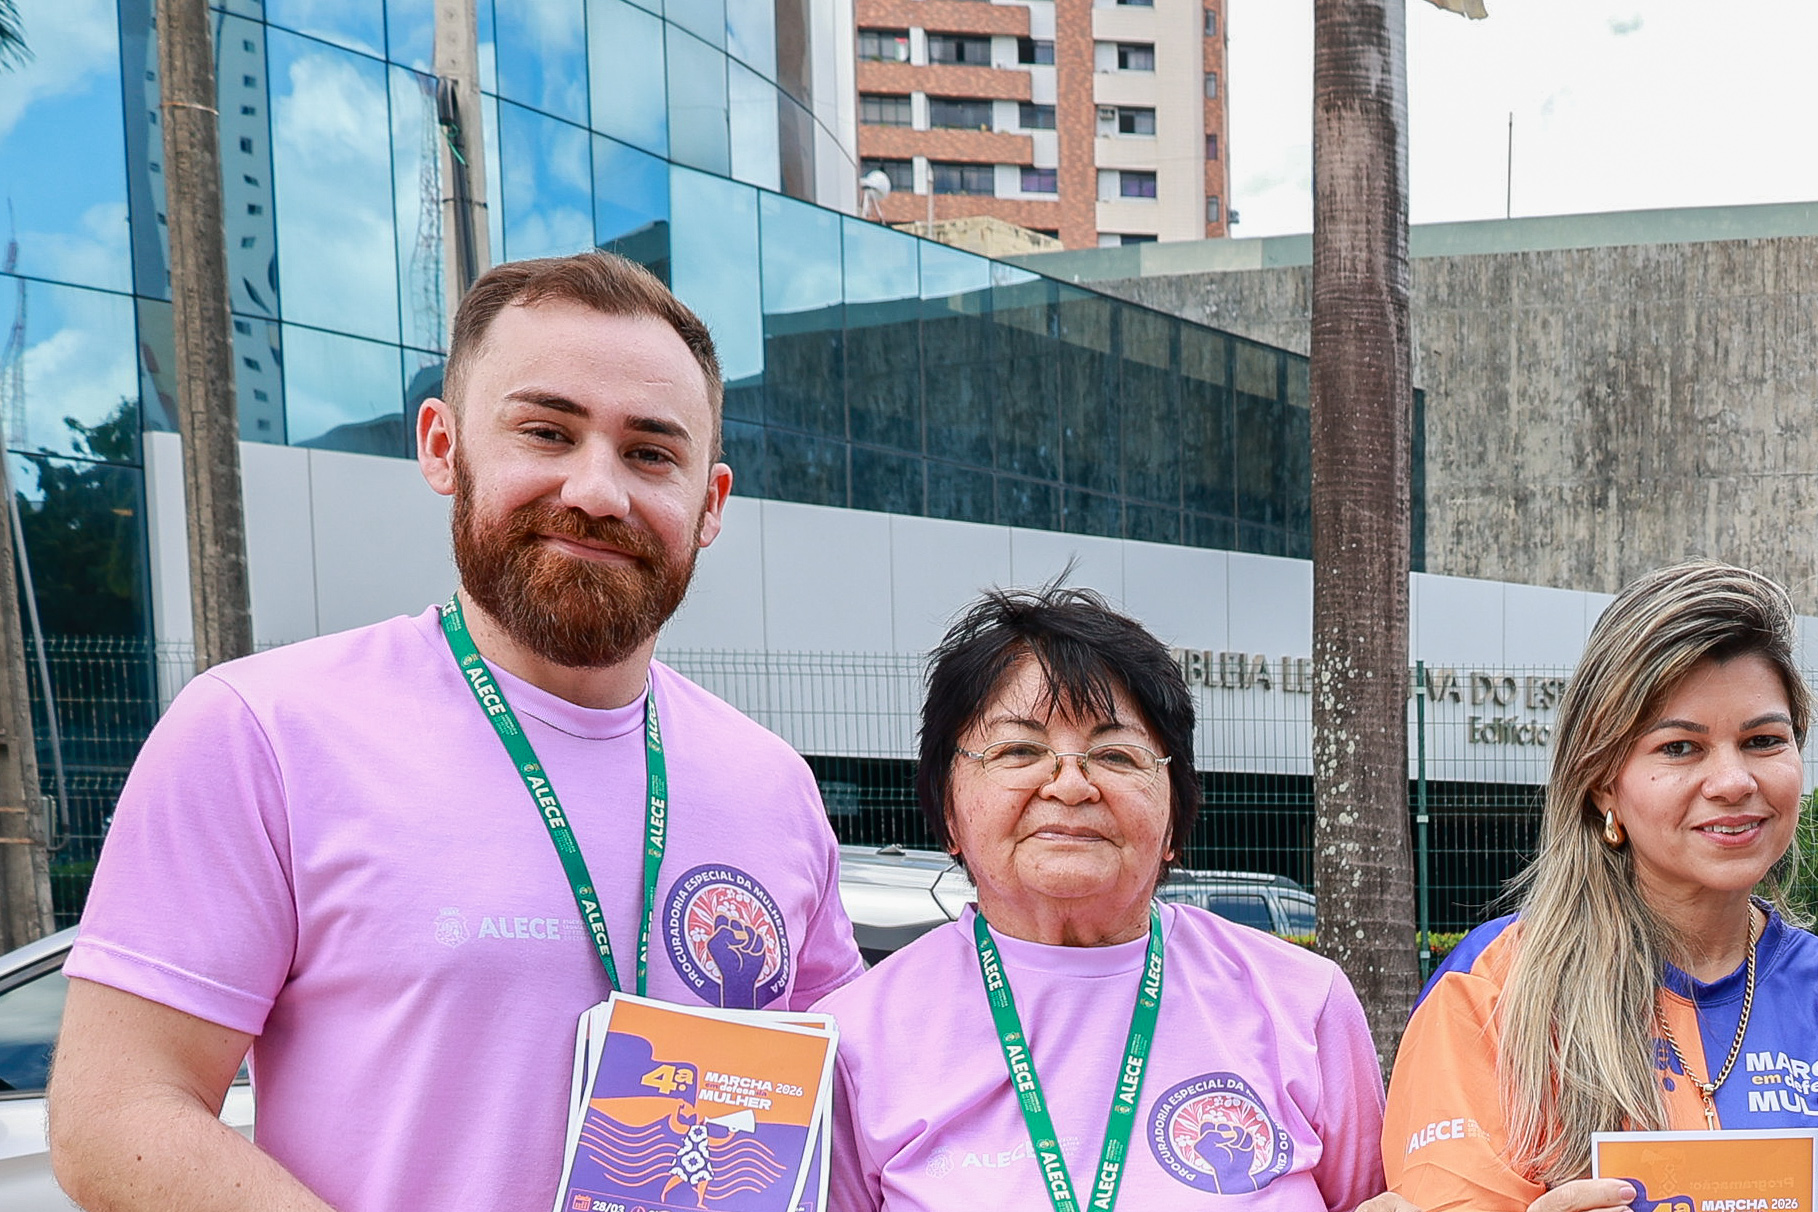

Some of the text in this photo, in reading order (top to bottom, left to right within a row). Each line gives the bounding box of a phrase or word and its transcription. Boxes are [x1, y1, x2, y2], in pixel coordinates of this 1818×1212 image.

[466, 667, 507, 716] ALECE
[1470, 672, 1517, 706] DO
[527, 776, 566, 829] ALECE
[650, 796, 665, 849] ALECE
[684, 870, 734, 893] ESPECIAL
[736, 875, 752, 890] DA
[478, 916, 561, 940] ALECE
[581, 900, 610, 957] ALECE
[753, 887, 785, 935] MULHER
[670, 889, 705, 988] PROCURADORIA
[980, 949, 1003, 992] ALECE
[1144, 953, 1163, 999] ALECE
[704, 1071, 803, 1096] MARCHA 2026
[1006, 1045, 1035, 1093] ALECE
[1119, 1055, 1143, 1104] ALECE
[1751, 1073, 1782, 1085] em
[698, 1089, 772, 1110] MULHER
[1155, 1078, 1289, 1181] PROCURADORIA ESPECIAL DA DO
[1408, 1117, 1465, 1155] ALECE
[1040, 1151, 1070, 1201] ALECE
[1096, 1161, 1119, 1210] ALECE
[1701, 1198, 1798, 1211] MARCHA 2026
